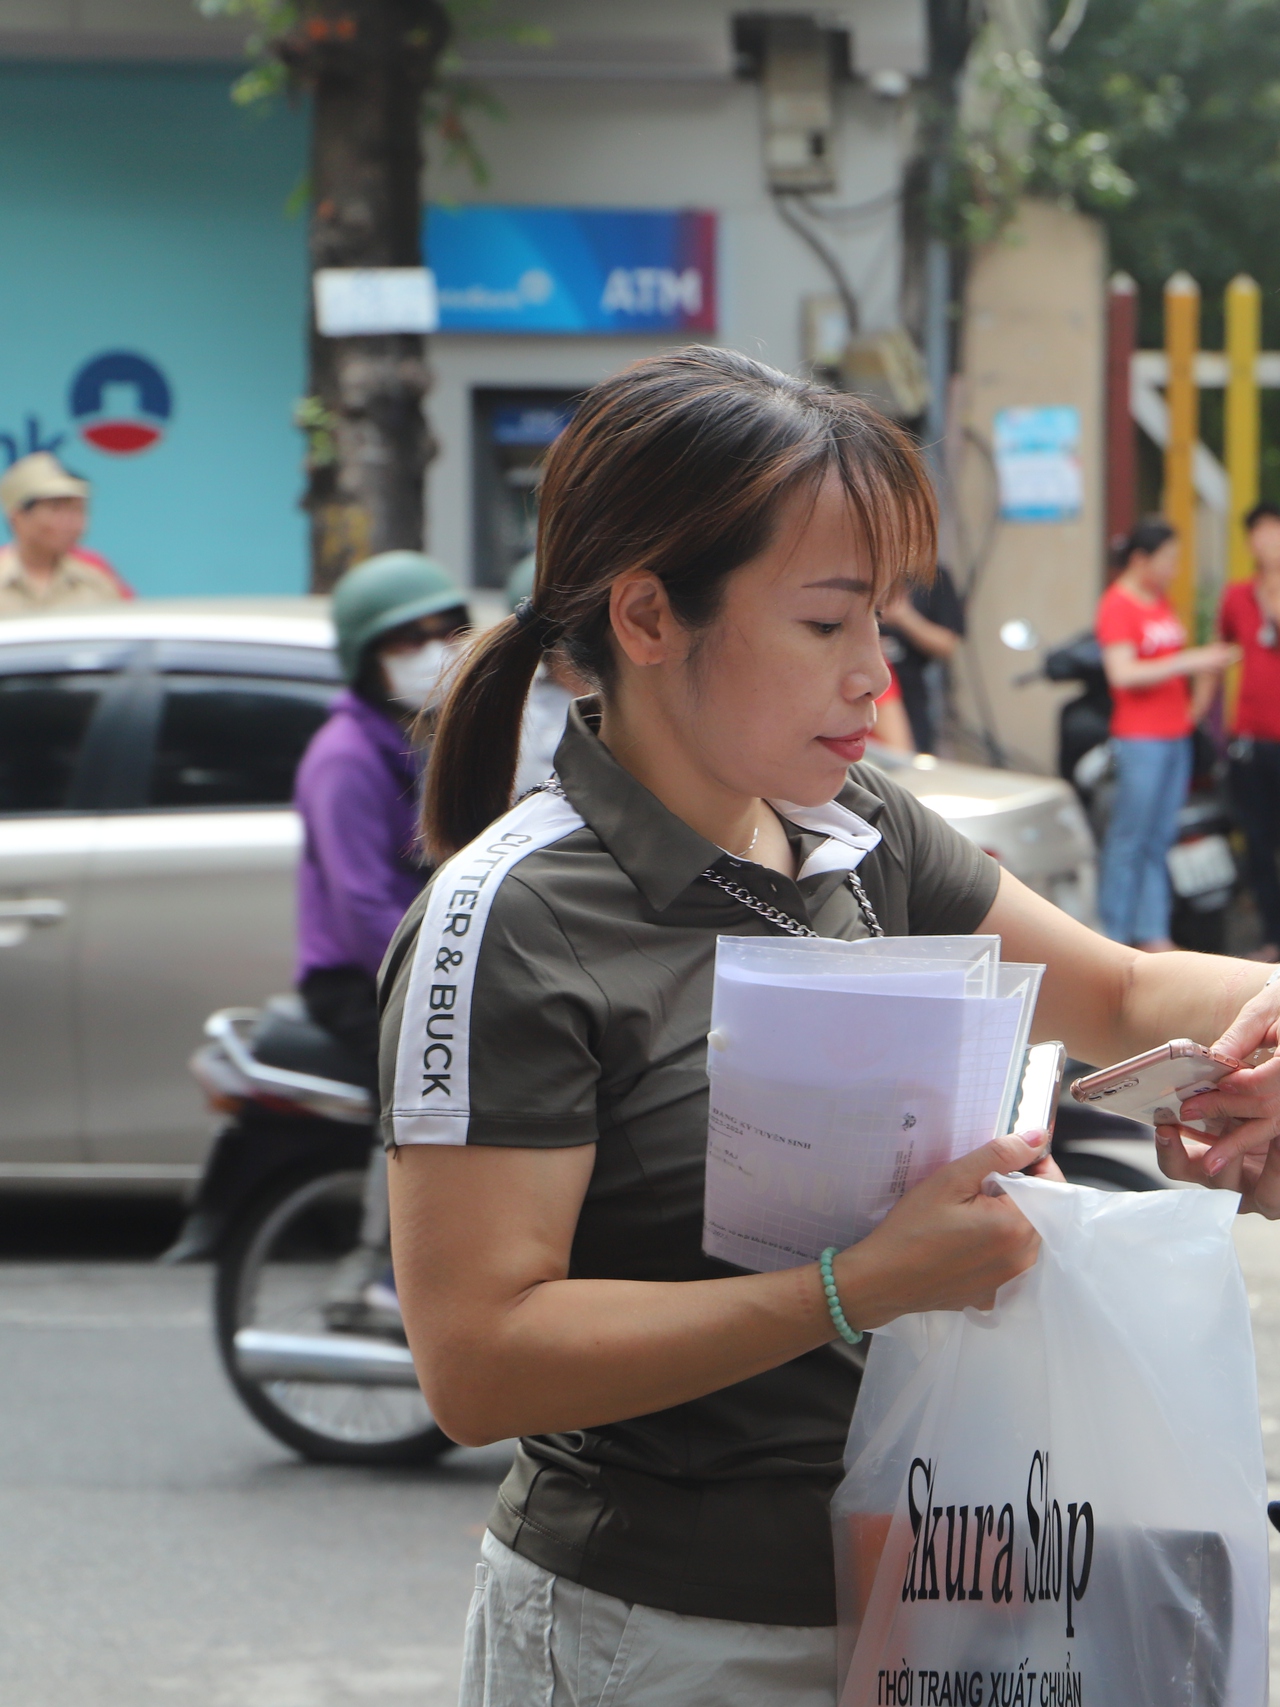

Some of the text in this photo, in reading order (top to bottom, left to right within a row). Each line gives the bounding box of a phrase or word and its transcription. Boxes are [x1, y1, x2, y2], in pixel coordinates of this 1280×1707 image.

[602, 267, 703, 316] ATM
[421, 833, 532, 1097] CUTTER & BUCK
[1024, 1449, 1095, 1638] Shop
[878, 1651, 1081, 1707] THỜI TRANG XUẤT CHUẨN
